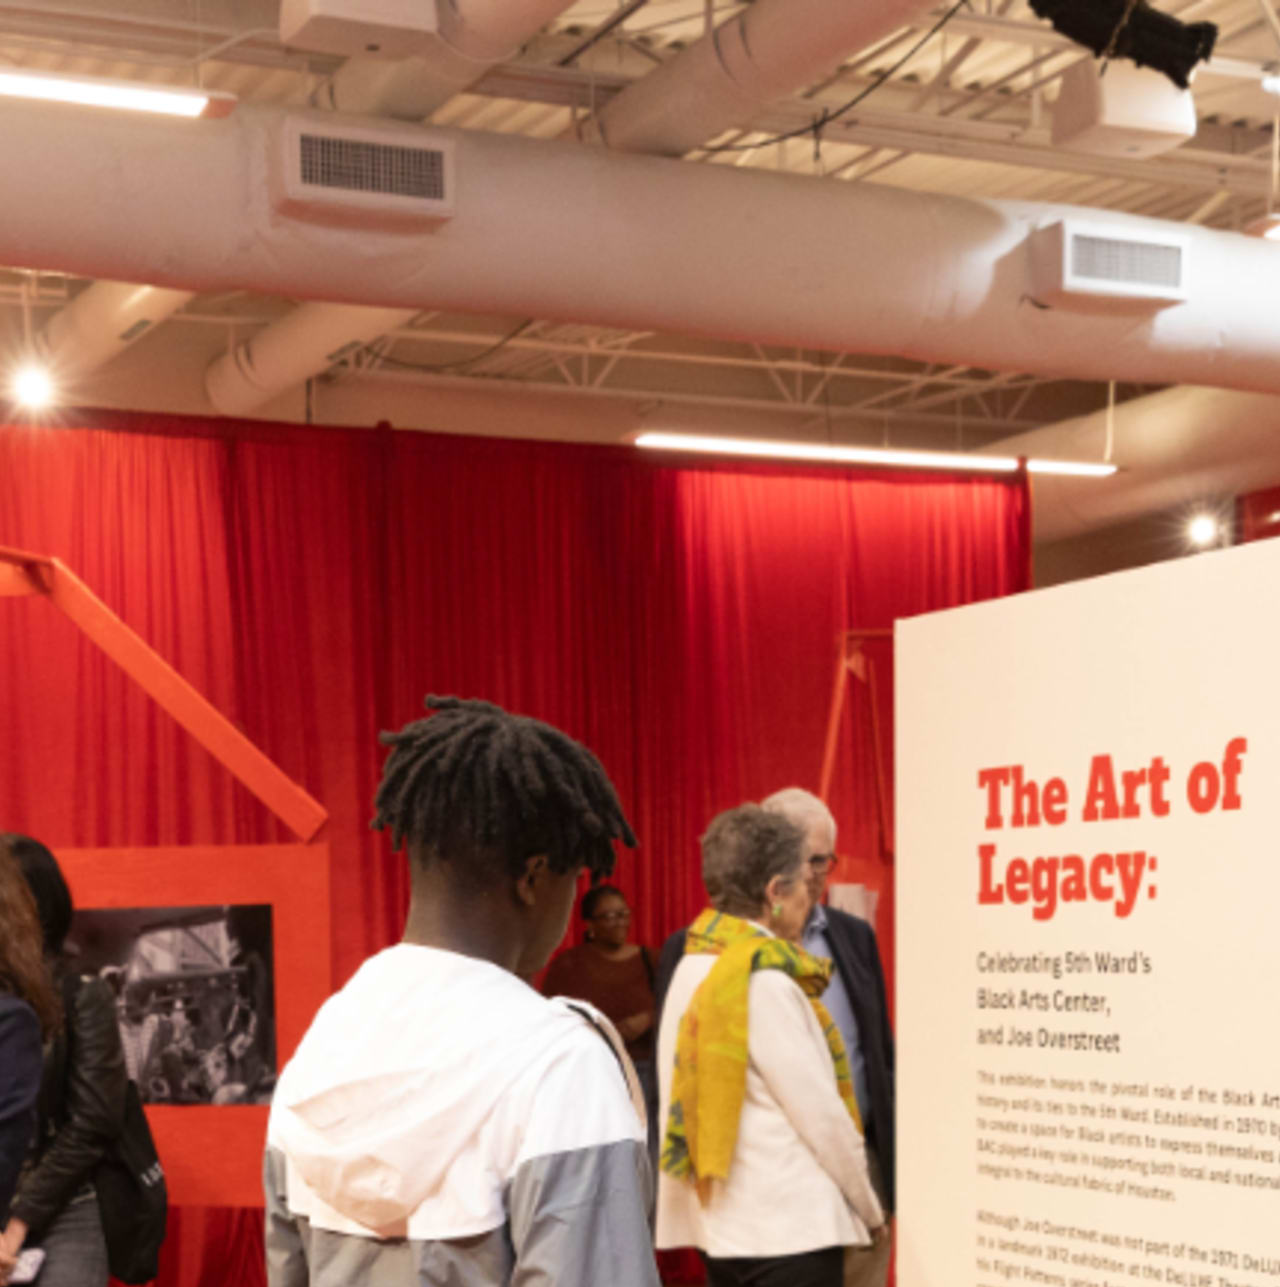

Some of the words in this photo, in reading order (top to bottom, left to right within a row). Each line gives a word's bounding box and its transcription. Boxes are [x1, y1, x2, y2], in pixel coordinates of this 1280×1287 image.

[978, 764, 1068, 829] The
[1082, 754, 1170, 822] Art
[1186, 736, 1247, 814] of
[978, 843, 1157, 920] Legacy:
[977, 951, 1062, 979] Celebrating
[1065, 951, 1092, 973] 5th
[1095, 951, 1151, 974] Ward's
[977, 987, 1015, 1009] Black
[1018, 989, 1050, 1012] Arts
[1053, 990, 1111, 1017] Center,
[977, 1025, 1003, 1045] and
[1008, 1026, 1032, 1047] Joe
[1036, 1027, 1120, 1053] Overstreet
